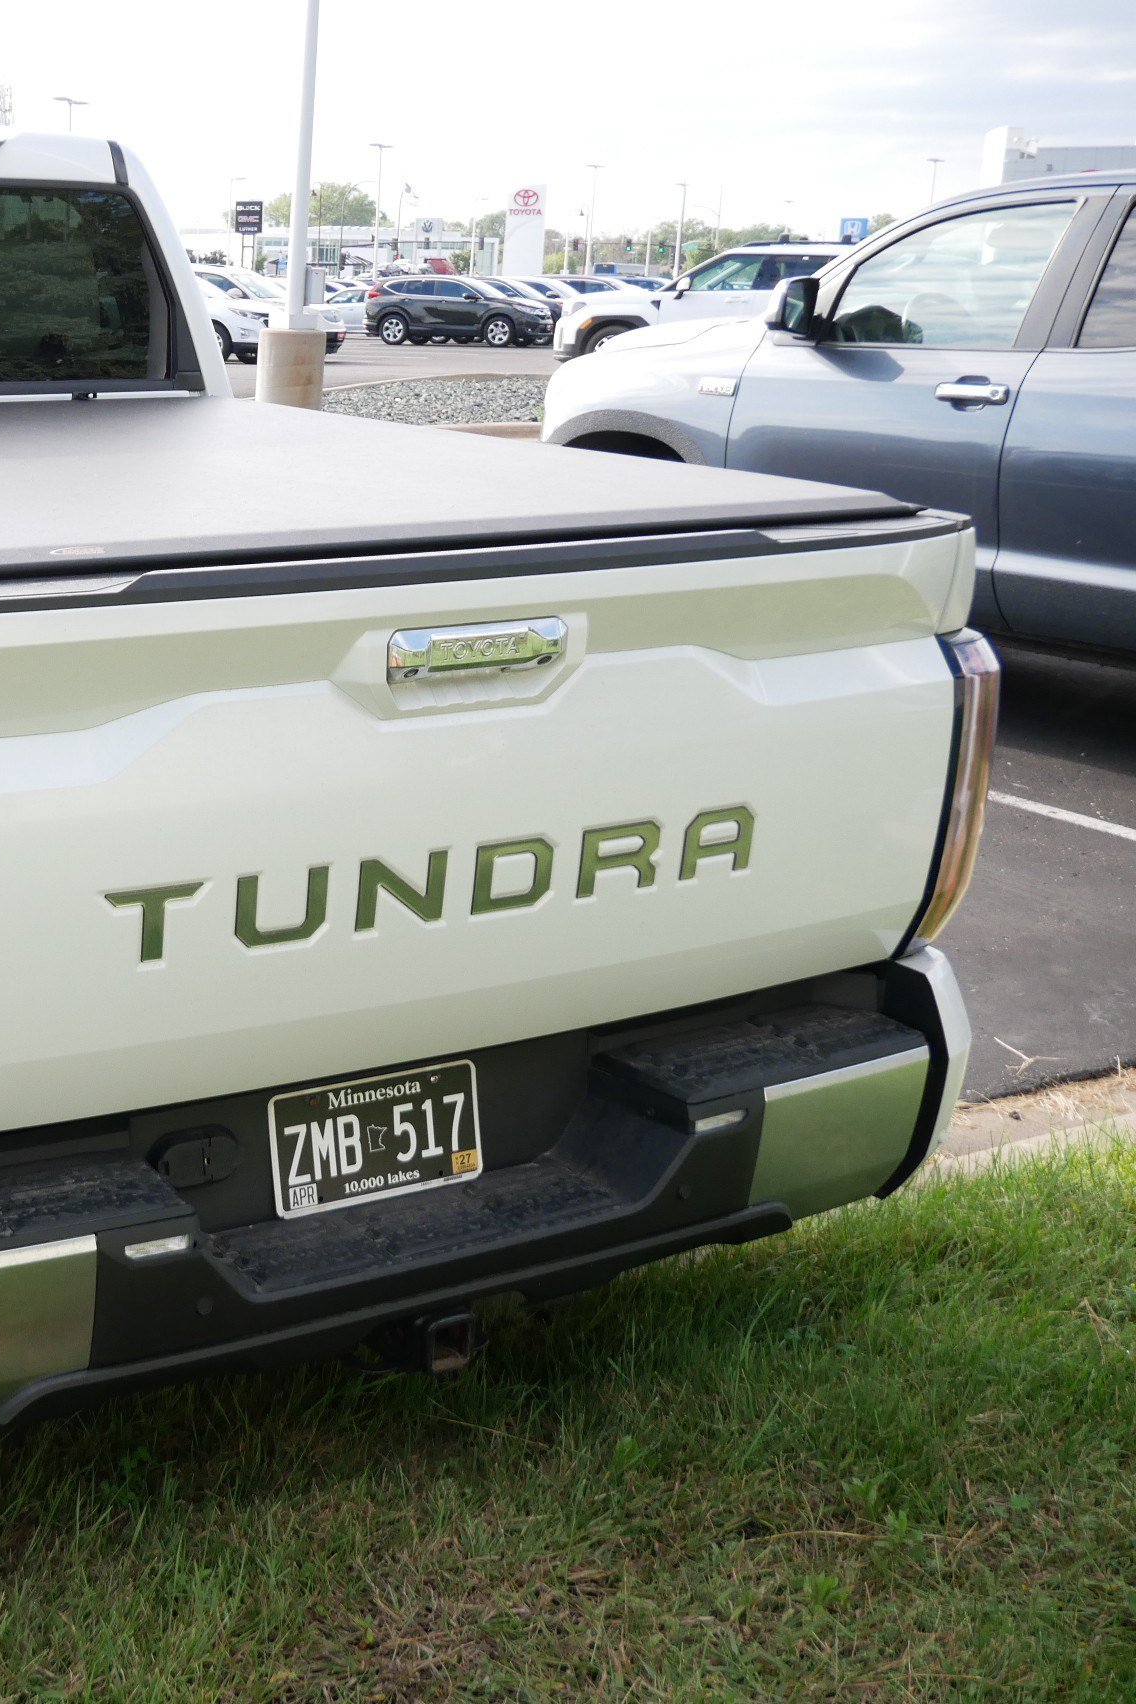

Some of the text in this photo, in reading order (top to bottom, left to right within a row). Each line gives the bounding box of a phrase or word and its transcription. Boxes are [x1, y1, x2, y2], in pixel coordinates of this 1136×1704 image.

[237, 215, 260, 223] GMC
[509, 208, 543, 216] TOYOTA
[441, 636, 520, 661] TOYOTA
[104, 804, 756, 964] TUNDRA
[328, 1080, 421, 1110] Minnesota
[284, 1092, 465, 1186] ZMB 517
[459, 1153, 471, 1165] 27
[344, 1169, 420, 1195] 10,000 lakes
[292, 1186, 315, 1207] APR
